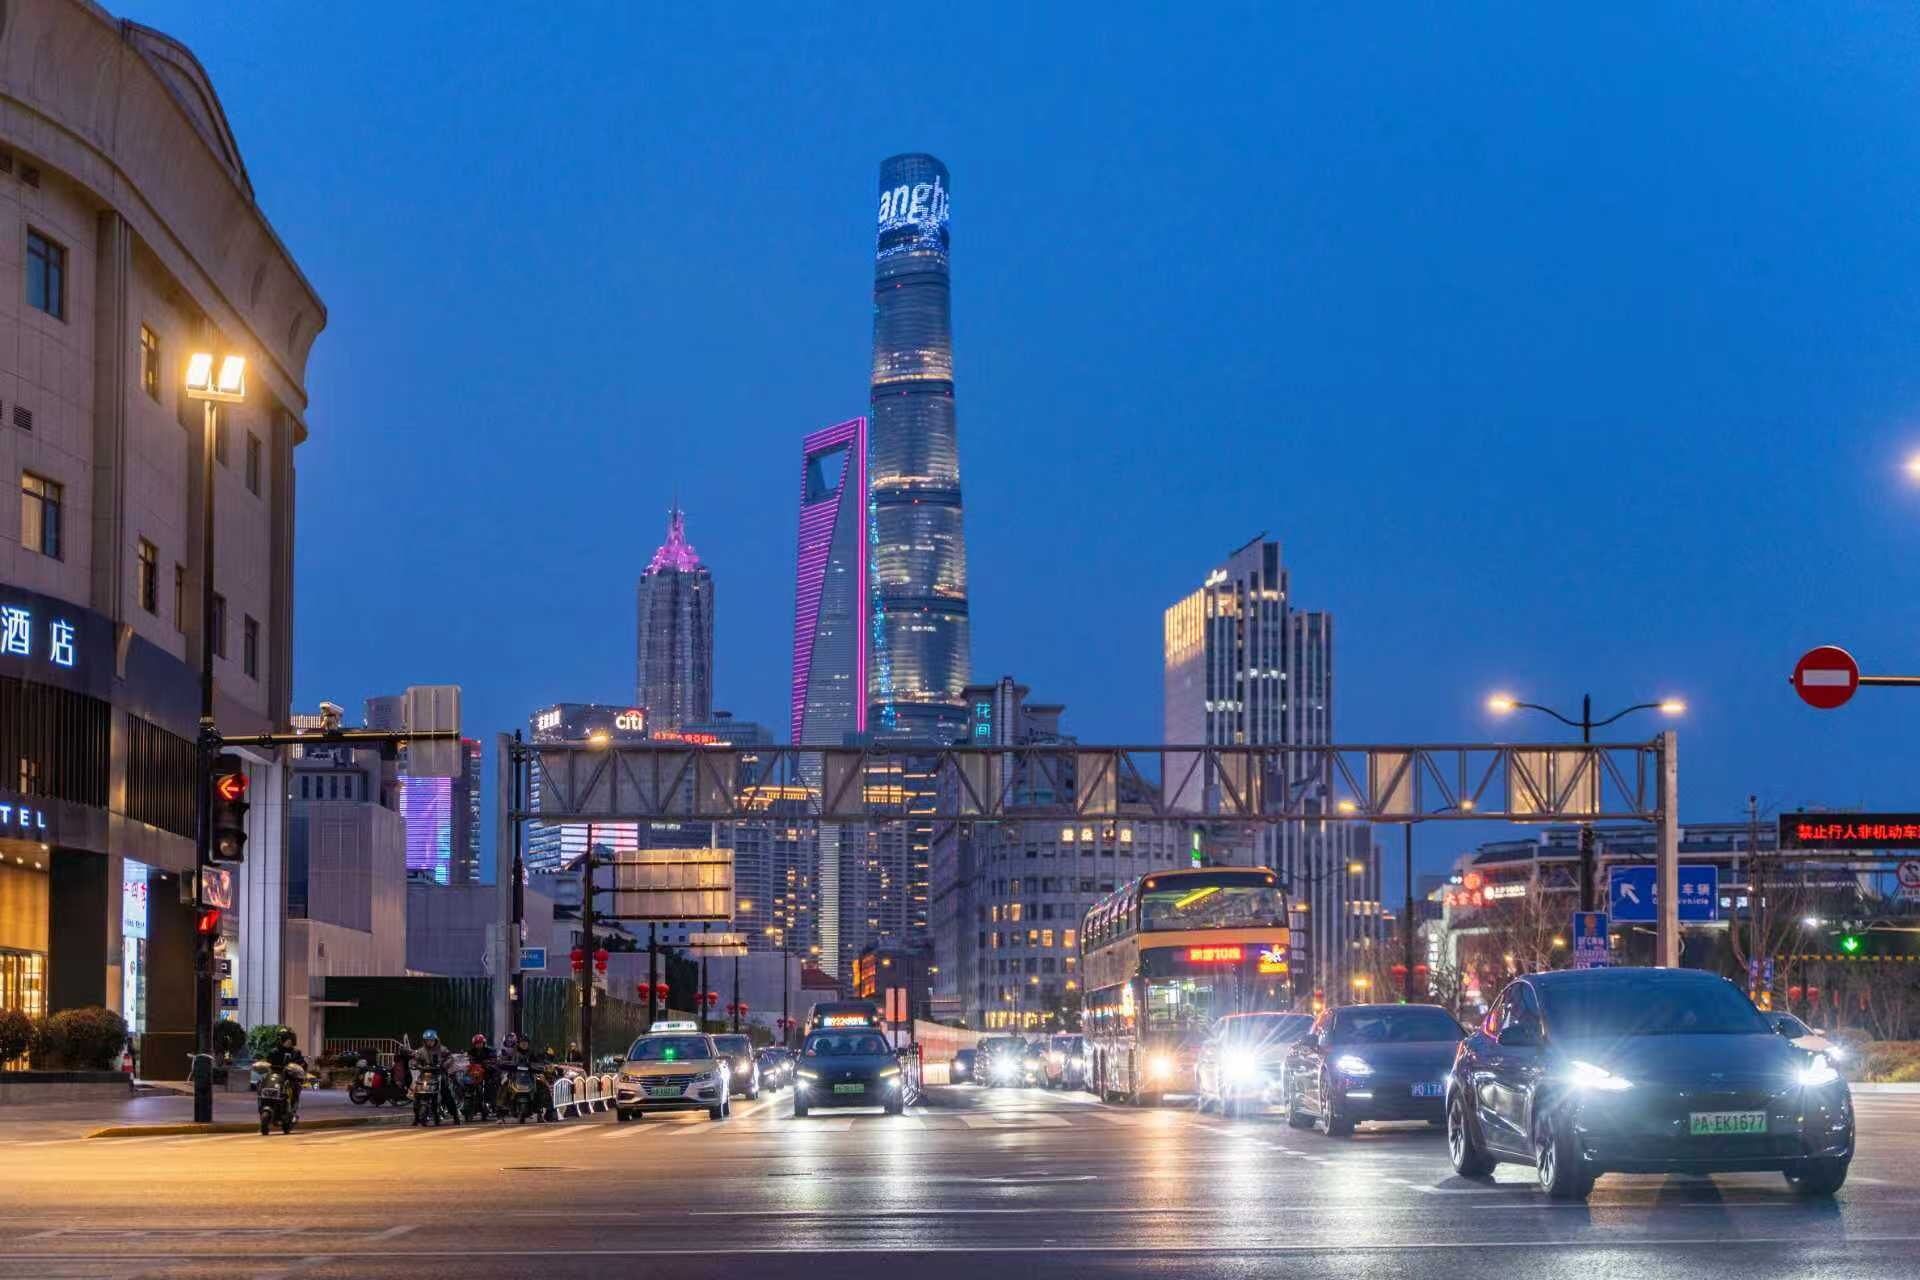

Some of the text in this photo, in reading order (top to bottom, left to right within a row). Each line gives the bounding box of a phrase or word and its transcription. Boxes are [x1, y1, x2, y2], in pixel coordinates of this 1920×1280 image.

[1, 605, 74, 666] 酒店
[616, 713, 643, 730] citi
[976, 703, 991, 747] 花间
[0, 806, 46, 828] TEL
[1797, 824, 1920, 840] 禁止行人非机动车
